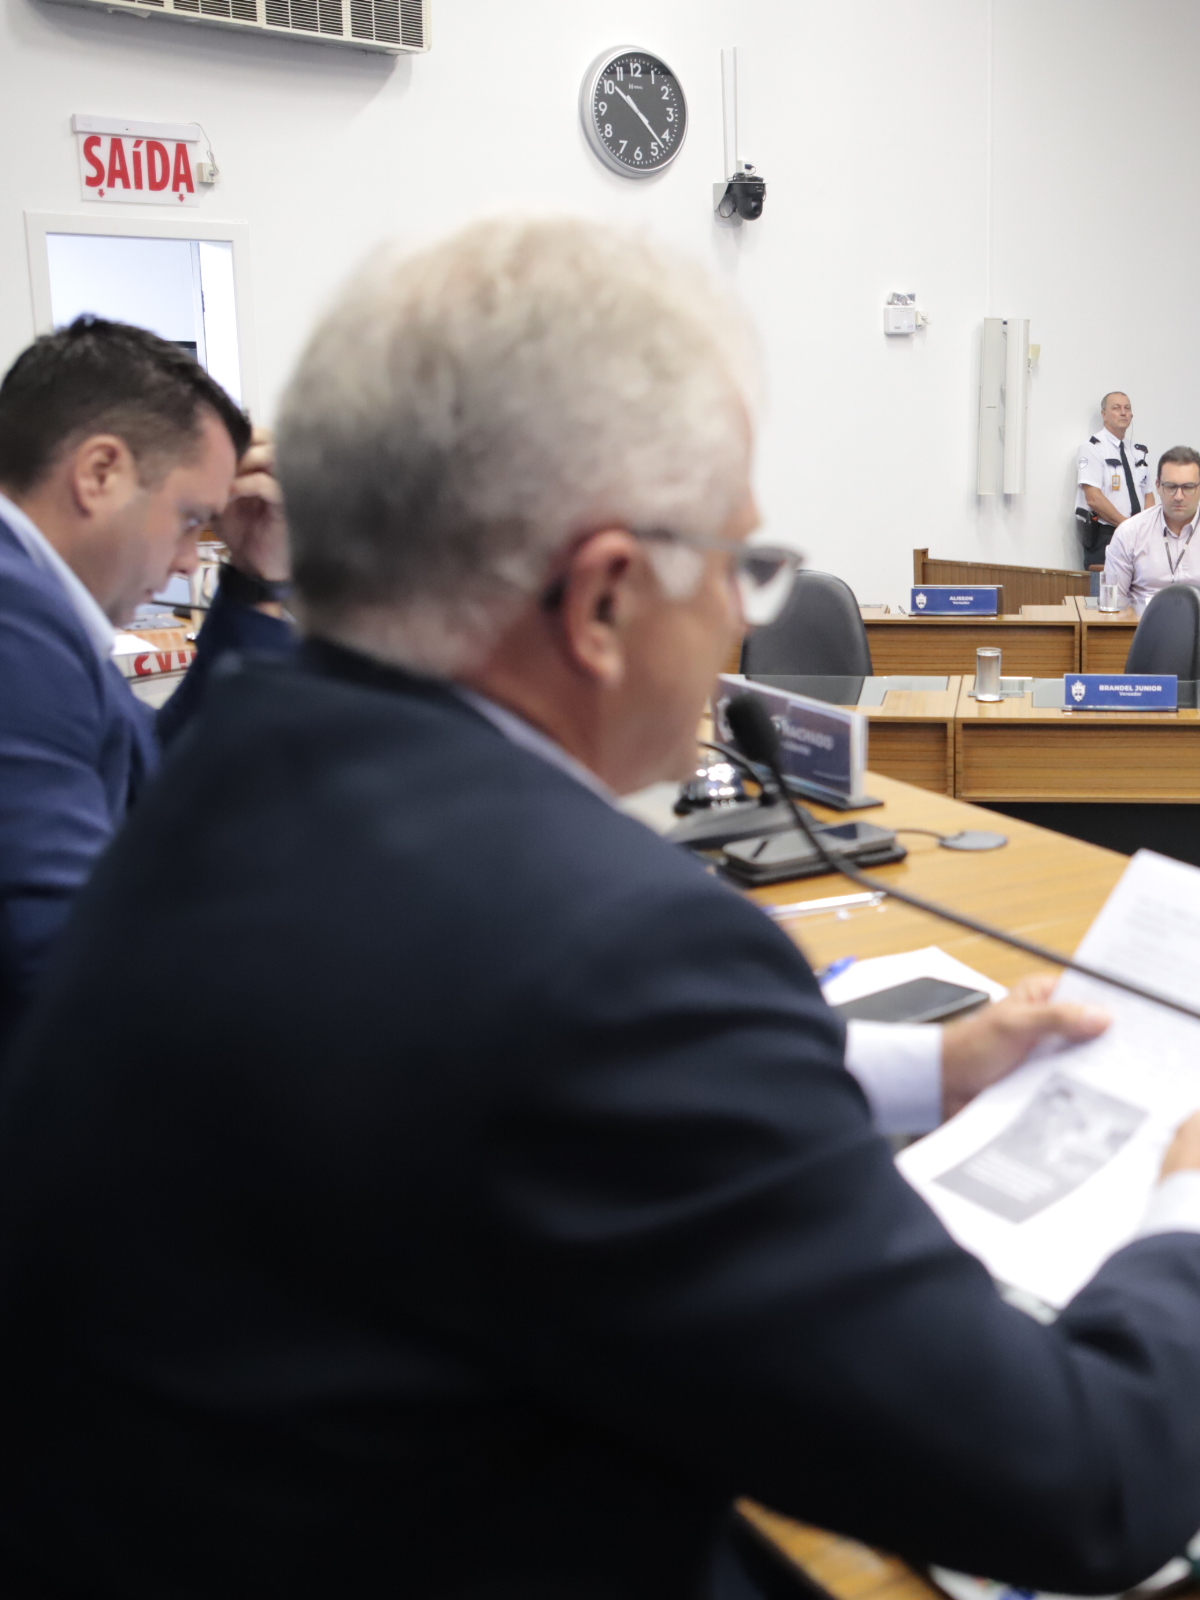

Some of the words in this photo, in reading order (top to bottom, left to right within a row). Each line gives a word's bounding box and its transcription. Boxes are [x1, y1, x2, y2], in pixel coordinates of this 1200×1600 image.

[616, 67, 623, 81] 11
[630, 62, 642, 77] 12
[651, 70, 655, 84] 1
[604, 80, 614, 94] 10
[661, 86, 669, 100] 2
[598, 102, 607, 116] 9
[666, 108, 674, 122] 3
[605, 124, 612, 137] 8
[661, 129, 670, 142] 4
[619, 140, 628, 153] 7
[634, 147, 642, 160] 6
[651, 142, 658, 156] 5
[83, 136, 194, 193] SAÍDA
